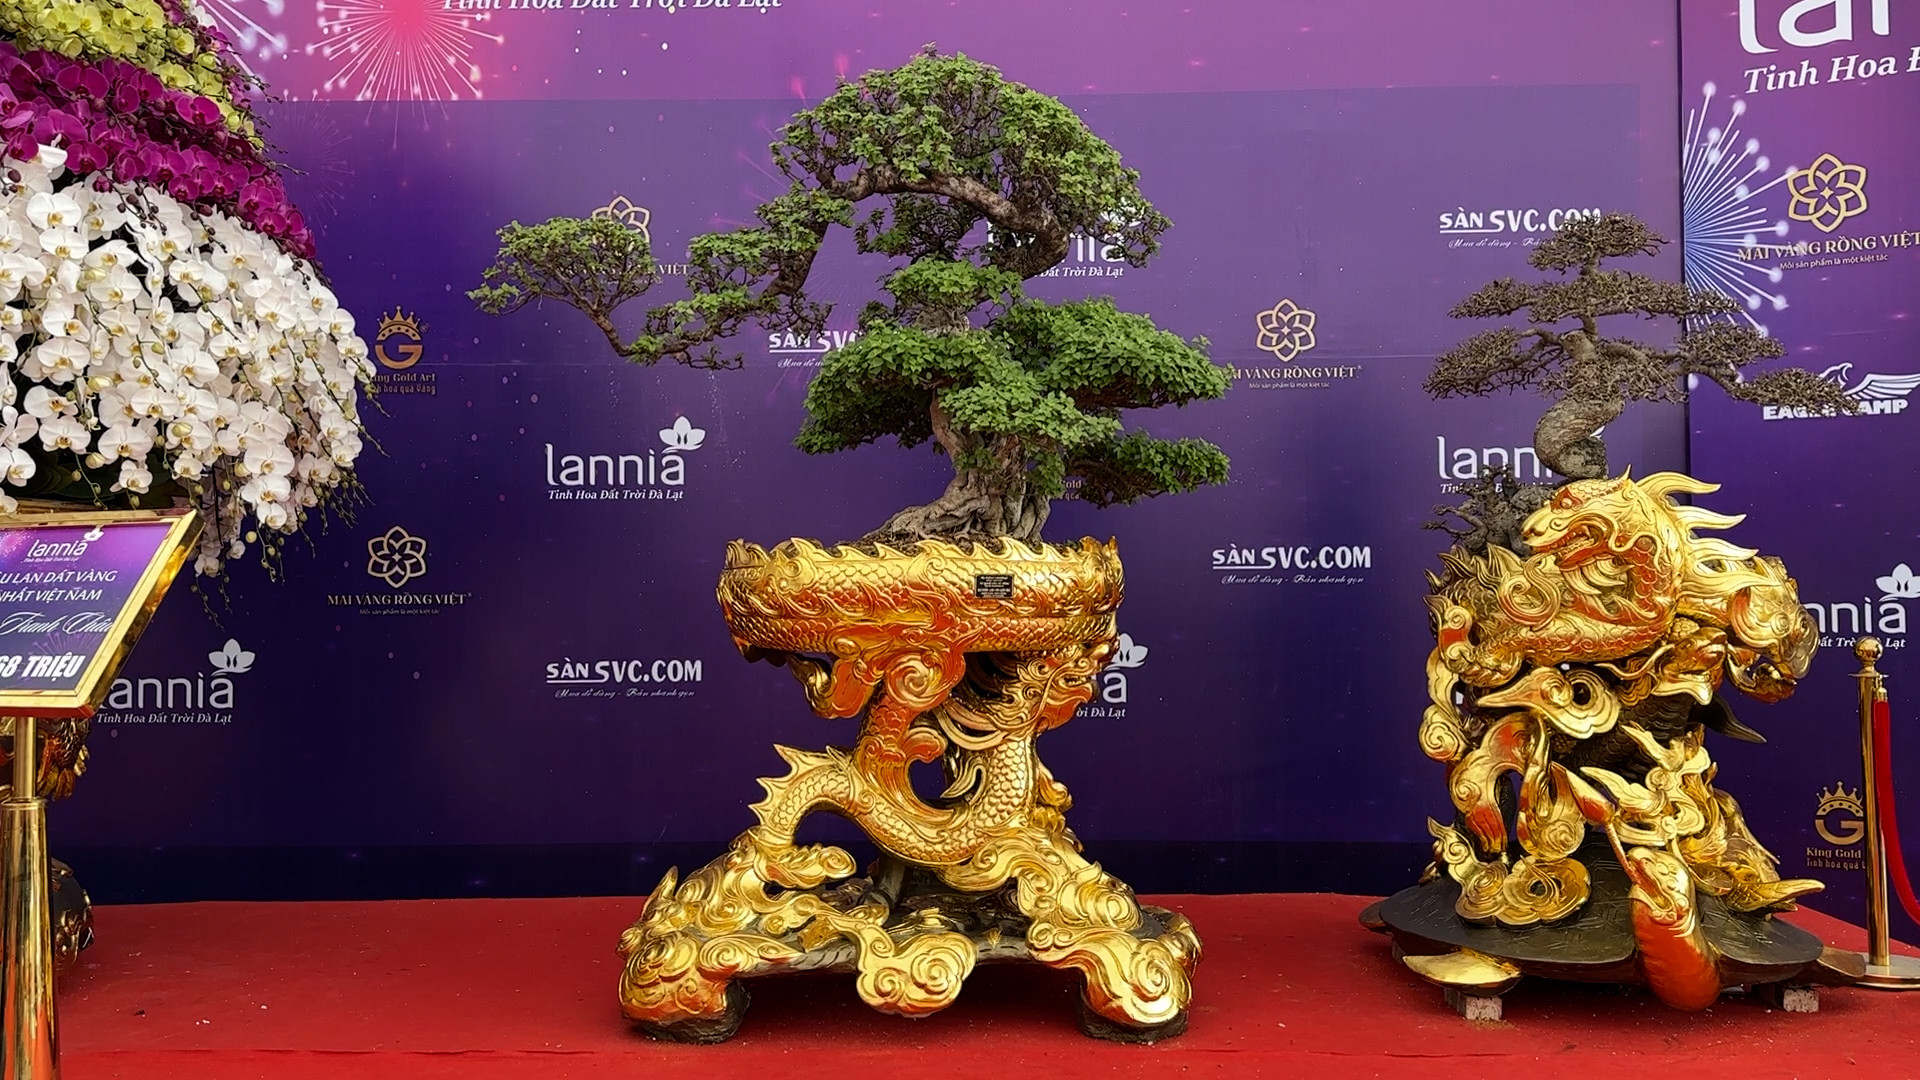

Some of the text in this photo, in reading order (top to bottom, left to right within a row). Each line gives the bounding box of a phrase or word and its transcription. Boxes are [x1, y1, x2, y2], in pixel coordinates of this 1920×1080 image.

[1744, 60, 1819, 94] Tinh
[1827, 55, 1897, 83] Hoa
[1439, 206, 1484, 229] SÀN
[1737, 230, 1920, 262] MAI VÀNG RỒNG VIỆT
[1063, 266, 1087, 277] Trời
[1088, 266, 1103, 276] Đà
[1106, 266, 1124, 278] Lạt
[769, 327, 811, 348] SÀN
[393, 373, 417, 382] Gold
[1245, 366, 1280, 379] VÀNG
[1283, 364, 1322, 379] RỒNG
[1763, 403, 1837, 420] EAG
[545, 443, 685, 486] lannia
[1437, 436, 1554, 480] lann
[1063, 479, 1082, 489] old
[548, 487, 684, 502] Tinh Hoa Đất Trời Đà Lạt
[27, 539, 89, 557] lannia
[1212, 543, 1371, 569] SÀN SVC.COM
[12, 572, 44, 584] LAN
[76, 568, 118, 582] VÀNG
[35, 587, 66, 604] VIỆT
[64, 589, 103, 601] NAM
[327, 594, 352, 605] MAI
[356, 592, 391, 605] VÀNG
[394, 592, 432, 605] RỒNG
[1803, 596, 1907, 634] nnia
[1819, 635, 1833, 647] ất
[1885, 637, 1907, 650] Lạt
[22, 652, 86, 682] TRIỆU
[546, 656, 702, 683] SÀN SVC.COM
[100, 672, 234, 709] annia
[97, 711, 232, 725] Tinh Hoa Đất Trời Đà Lạt
[1091, 706, 1105, 717] Đà
[1108, 707, 1126, 719] Lạt
[1806, 847, 1862, 859] King Gold
[1825, 858, 1841, 869] hoa
